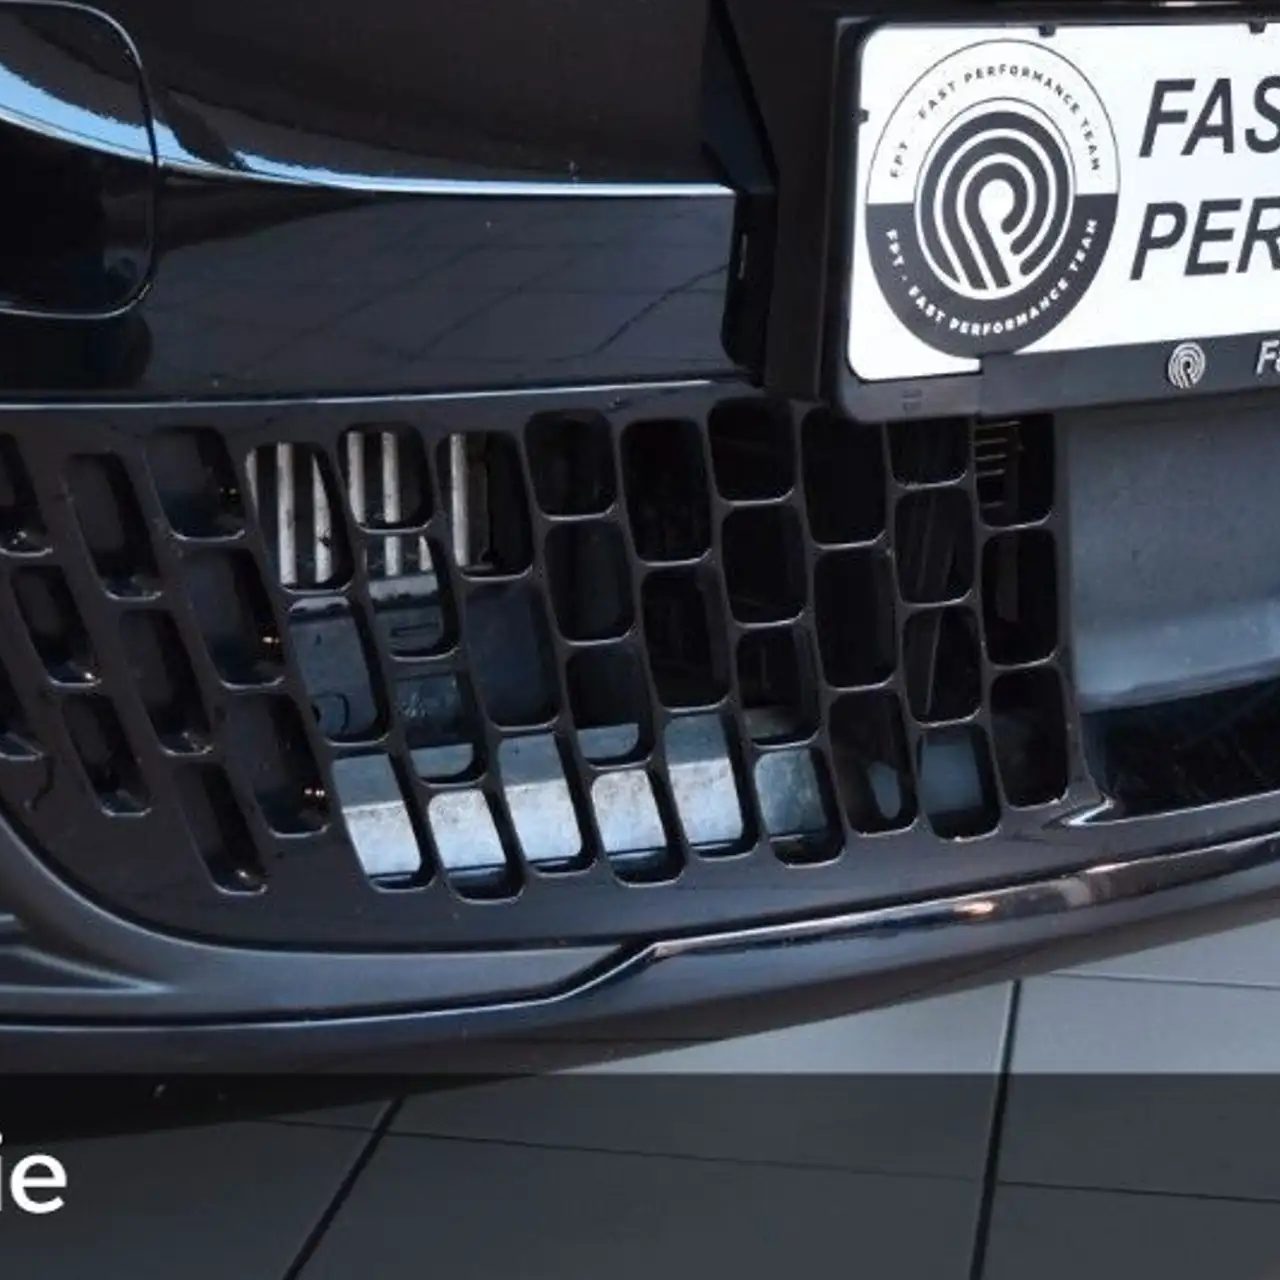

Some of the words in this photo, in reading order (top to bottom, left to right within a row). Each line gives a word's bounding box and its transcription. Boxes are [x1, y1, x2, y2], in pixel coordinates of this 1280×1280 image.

[918, 80, 957, 120] FAST
[963, 63, 1081, 114] PERFORMANCE
[1080, 118, 1101, 172] TEAM
[908, 285, 946, 324] FAST
[948, 277, 1069, 337] PERFORMANCE
[1069, 218, 1099, 273] TEAM
